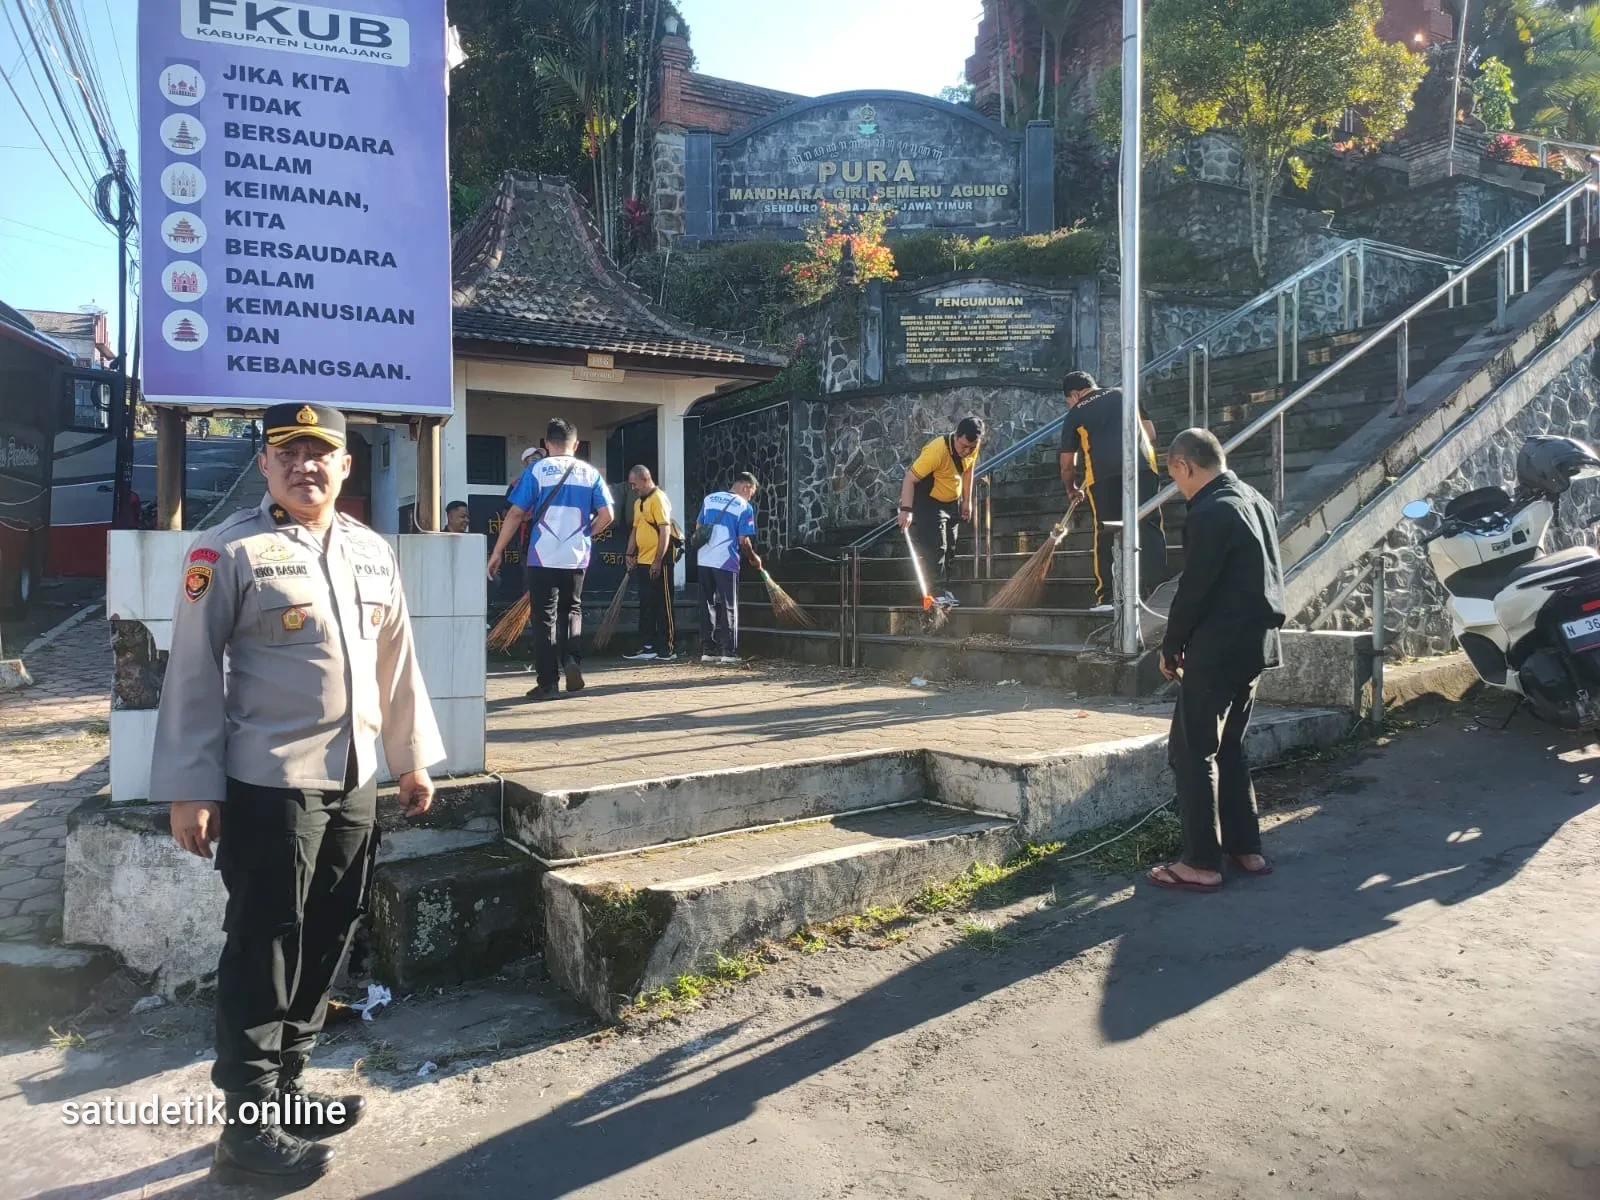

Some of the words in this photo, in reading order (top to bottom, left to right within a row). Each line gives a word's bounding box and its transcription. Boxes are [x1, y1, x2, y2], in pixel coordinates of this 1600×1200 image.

[199, 0, 393, 48] FKUB
[196, 27, 299, 48] KABUPATEN
[303, 41, 393, 61] LUMAJANG
[223, 64, 284, 87] JIKA
[292, 71, 351, 95] KITA
[223, 93, 302, 117] TIDAK
[224, 121, 395, 156] BERSAUDARA
[224, 151, 312, 175] DALAM
[818, 160, 916, 183] PURA
[225, 180, 369, 213] KEIMANAN,
[729, 186, 824, 201] MANDHARA
[876, 184, 942, 199] SEMERU
[950, 183, 1009, 198] AGUNG
[763, 203, 818, 213] SENDURO
[901, 201, 933, 211] JAWA
[937, 200, 973, 211] TIMUR
[225, 209, 286, 230] KITA
[225, 238, 398, 268] BERSAUDARA
[226, 267, 315, 290] DALAM
[226, 296, 415, 325] KEMANUSIAAN
[935, 296, 1024, 308] PENGUMUMAN
[226, 325, 280, 345] DAN
[227, 354, 411, 381] KEBANGSAAN.
[355, 564, 390, 578] POLRI
[1566, 625, 1577, 637] N
